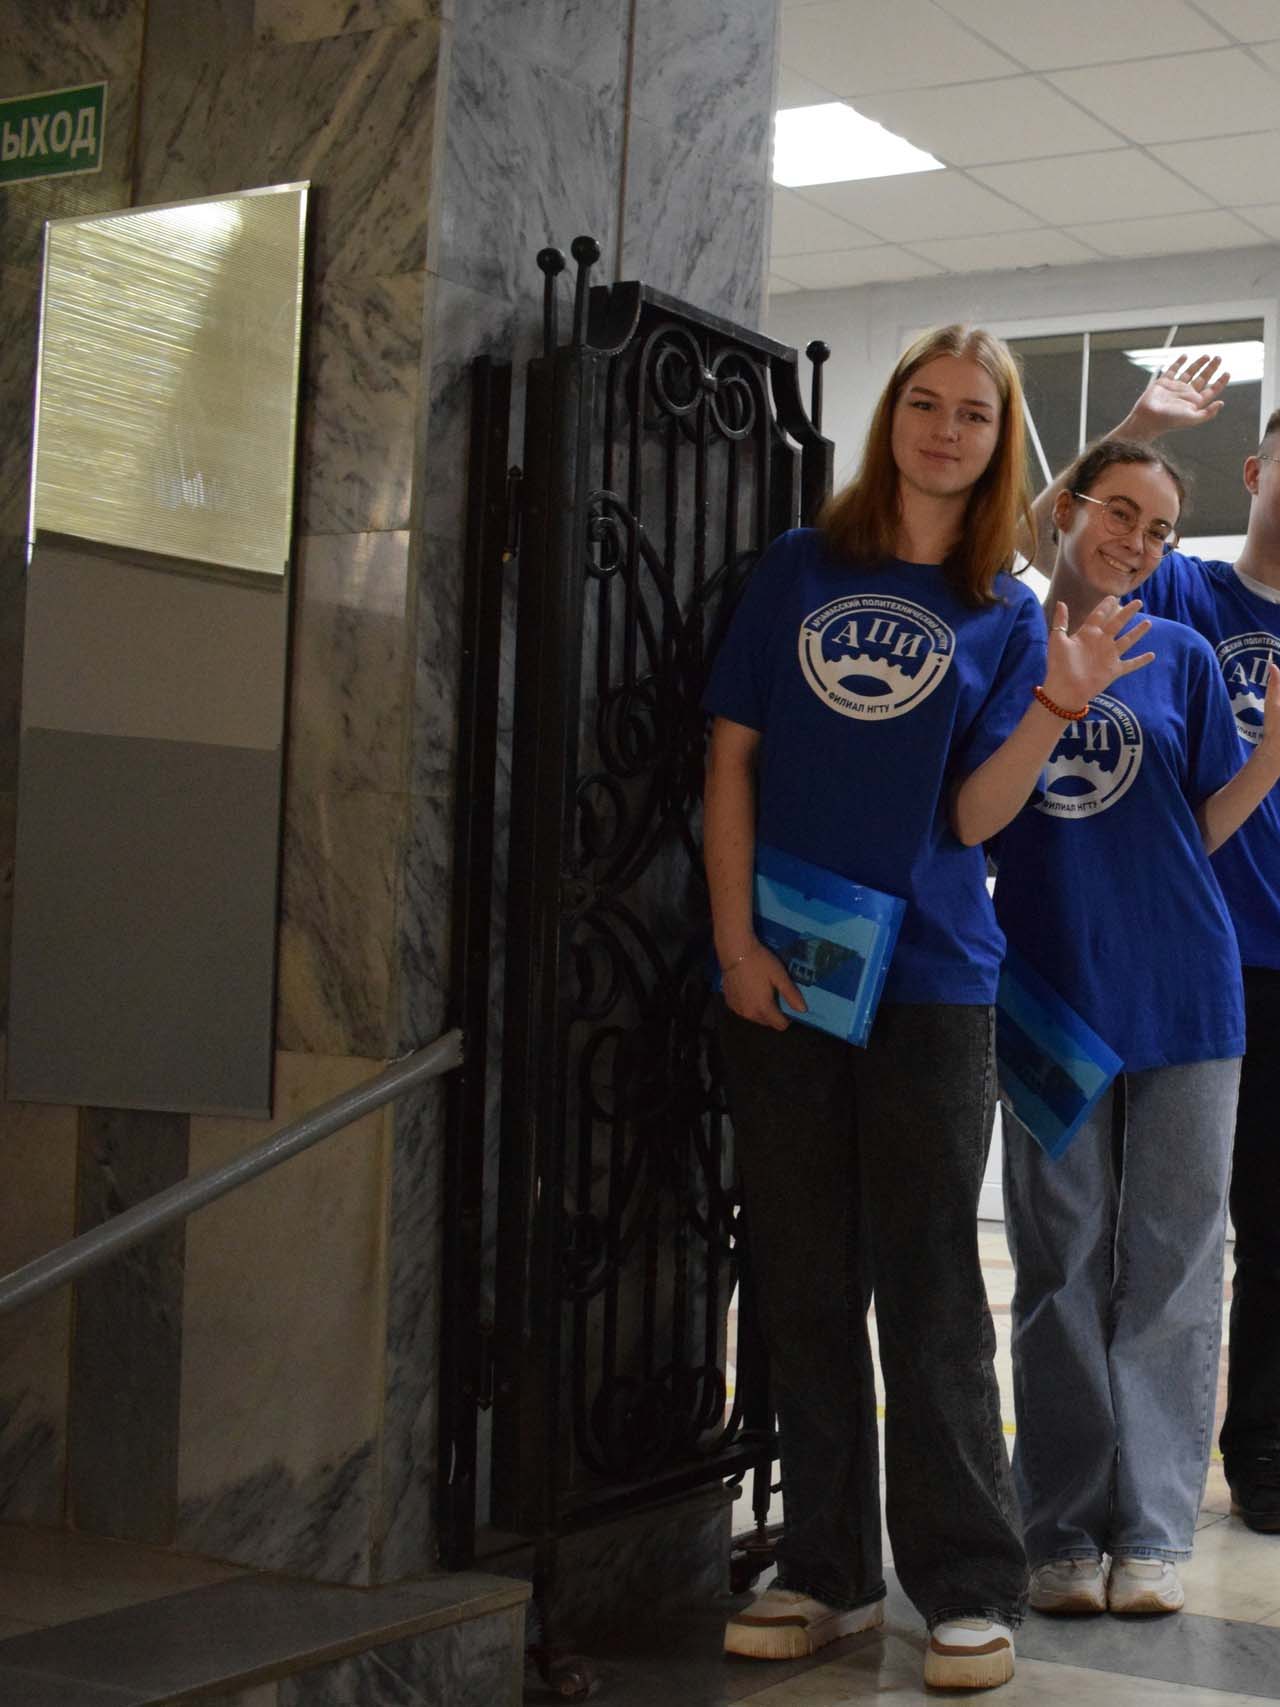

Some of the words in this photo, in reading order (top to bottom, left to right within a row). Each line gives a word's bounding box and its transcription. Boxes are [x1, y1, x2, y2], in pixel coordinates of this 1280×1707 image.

[1, 107, 96, 161] ЫХОД
[832, 618, 926, 657] АПИ
[828, 692, 865, 713] ФИЛИАЛ
[867, 704, 890, 713] НГТУ
